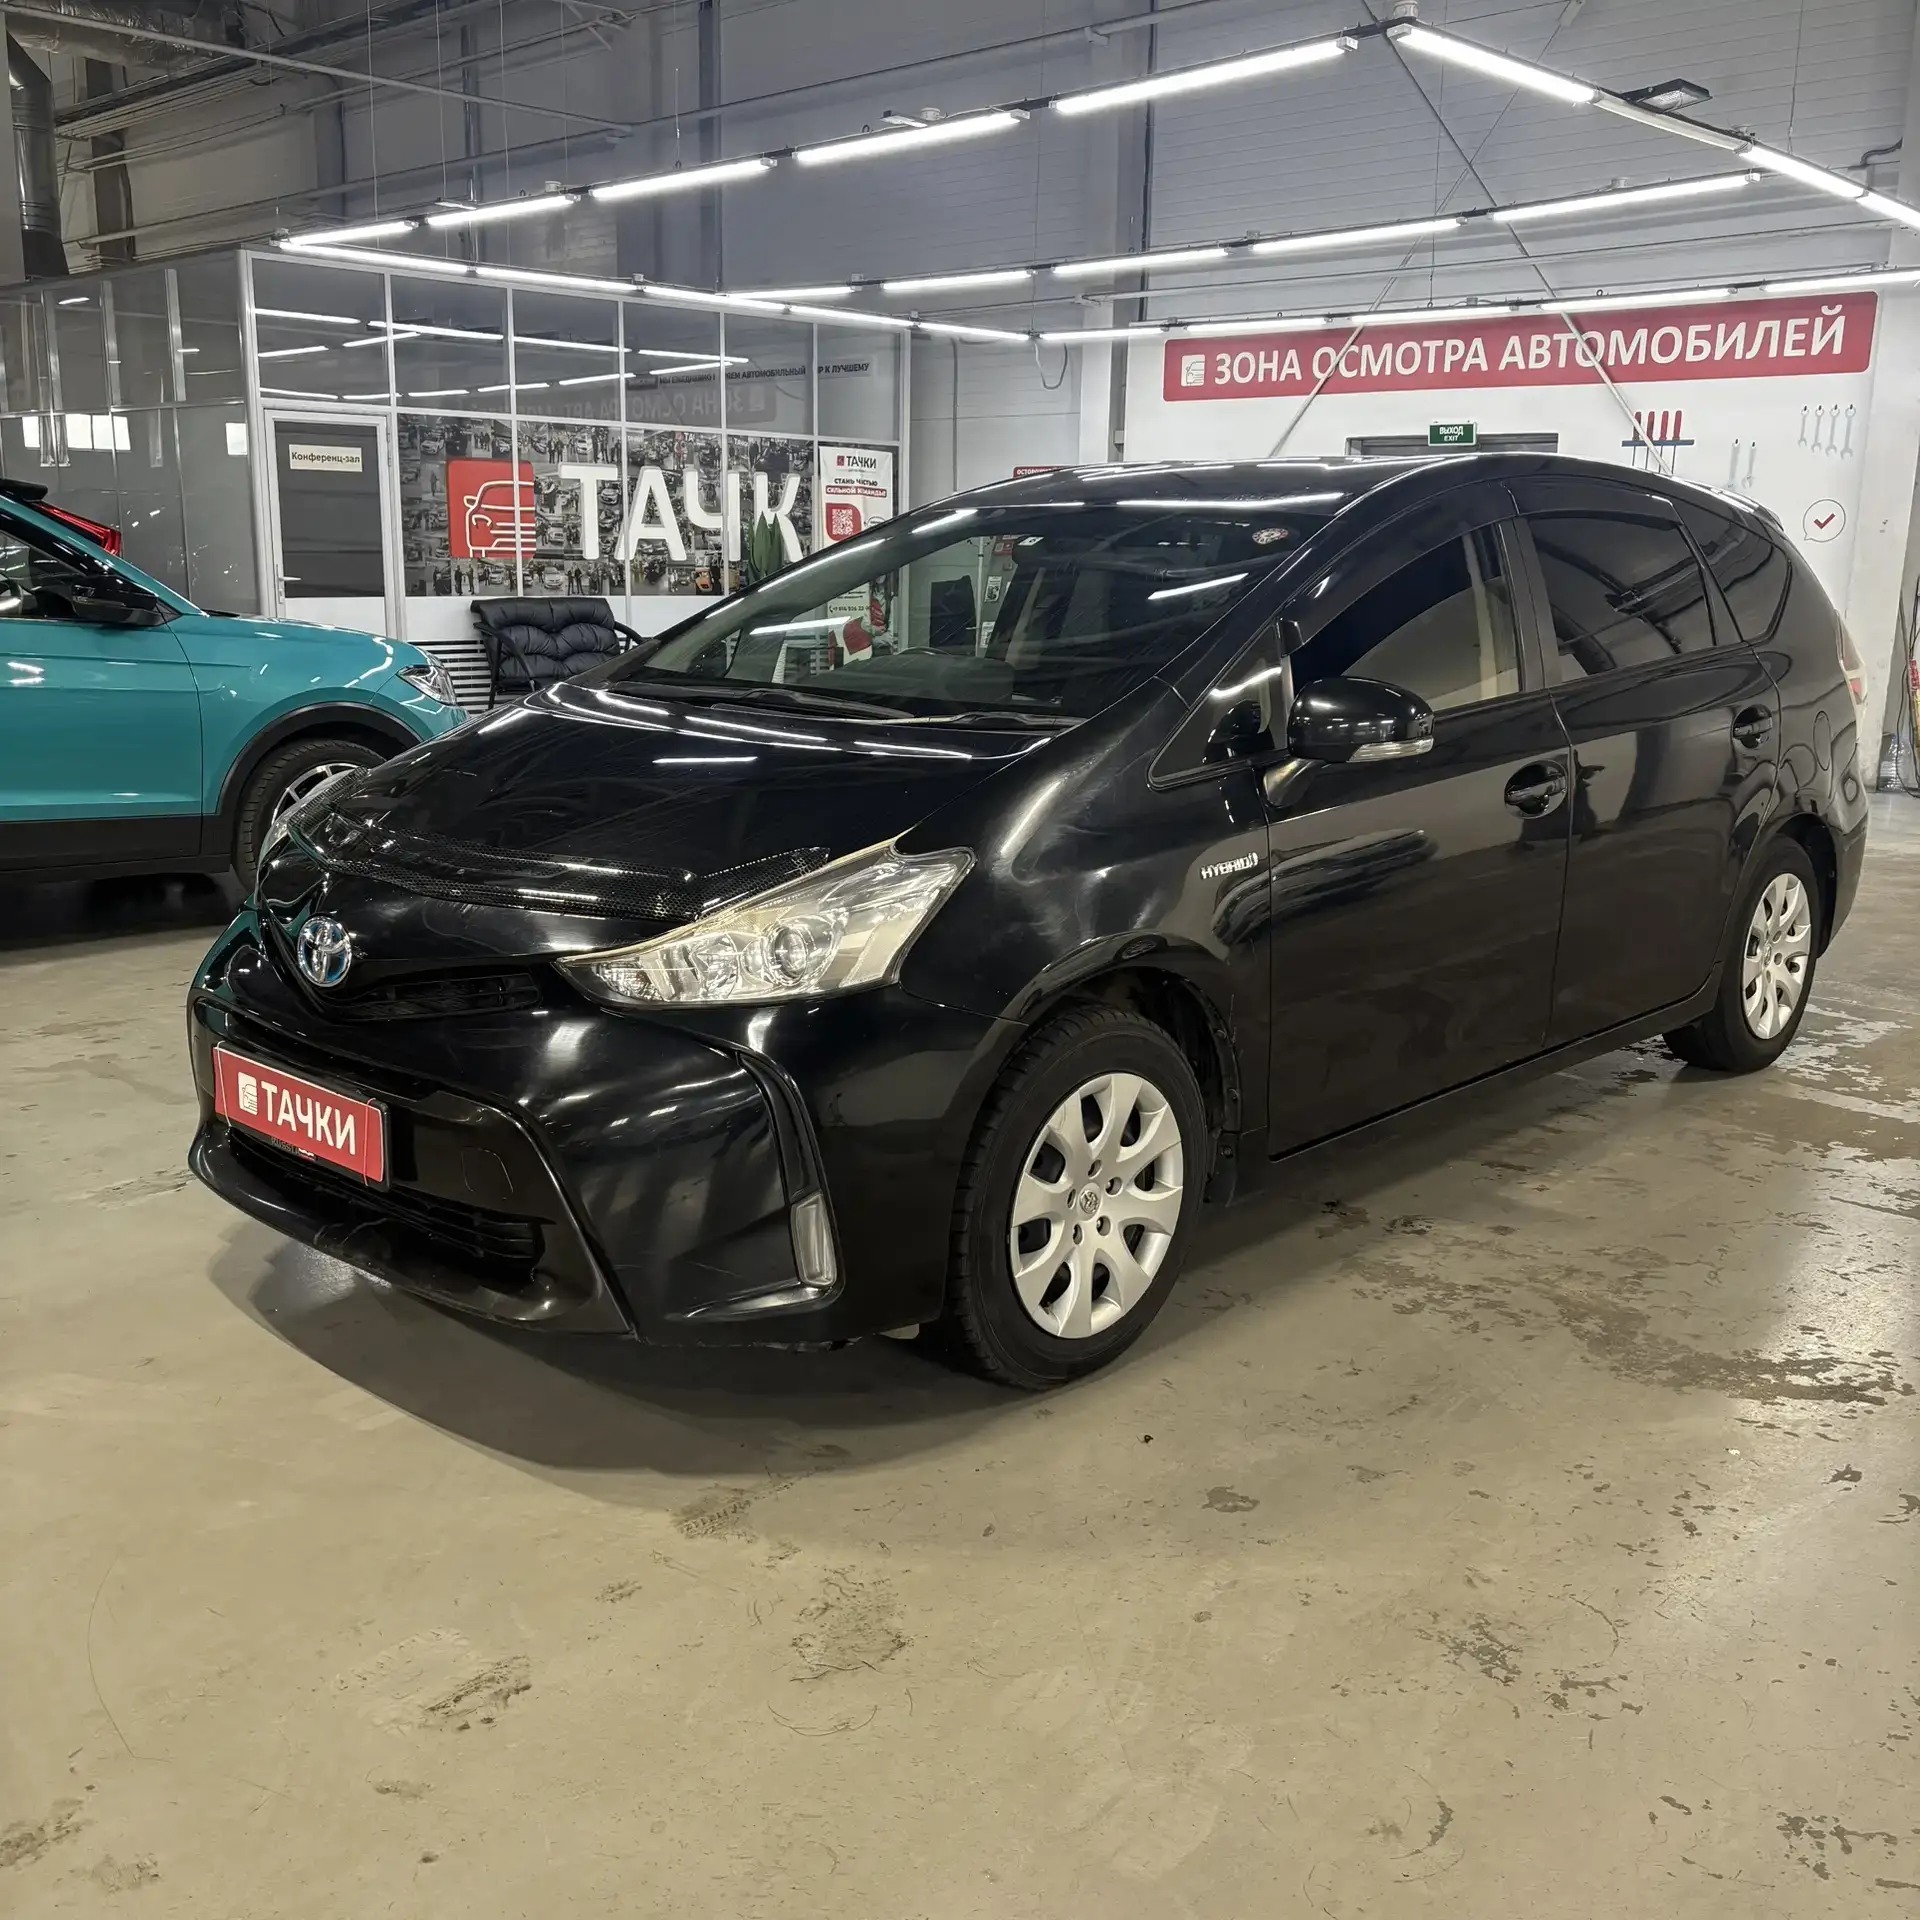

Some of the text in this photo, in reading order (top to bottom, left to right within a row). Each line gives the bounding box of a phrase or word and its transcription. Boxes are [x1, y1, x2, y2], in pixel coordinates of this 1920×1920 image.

[1214, 304, 1846, 385] ЗОНА ОСМОТРА АВТОМОБИЛЕЙ
[741, 365, 806, 380] АВТОМОБИЛЬНЫЙ
[831, 363, 870, 374] ЛУЧШЕМУ
[1439, 426, 1464, 436] ВЫХОД
[291, 451, 360, 463] Конференц-зал
[846, 455, 877, 469] ТАЧКИ
[856, 479, 878, 487] ЧАСТЬЮ
[826, 486, 857, 494] СИЛЬНОЙ
[1201, 855, 1253, 879] HYBRID
[260, 1080, 356, 1156] ТАЧКИ
